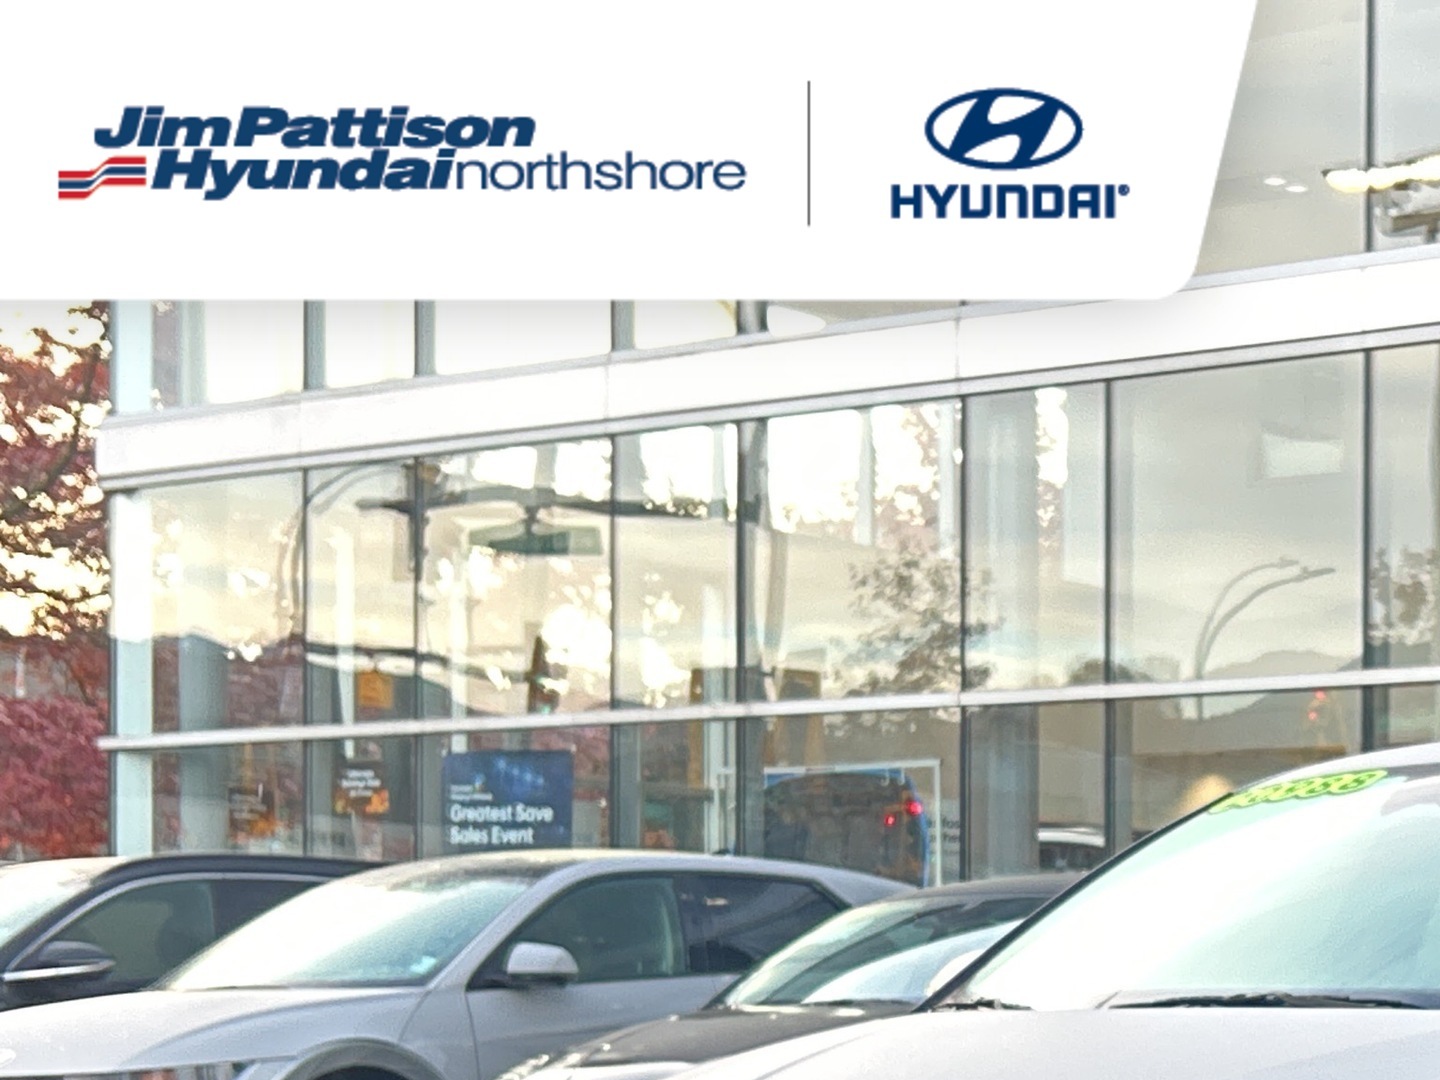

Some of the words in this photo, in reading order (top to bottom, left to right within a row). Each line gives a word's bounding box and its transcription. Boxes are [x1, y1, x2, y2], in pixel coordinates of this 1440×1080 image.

[450, 804, 512, 822] Greatest
[516, 803, 553, 822] Save
[450, 825, 488, 844] Sales
[491, 825, 534, 844] Event
